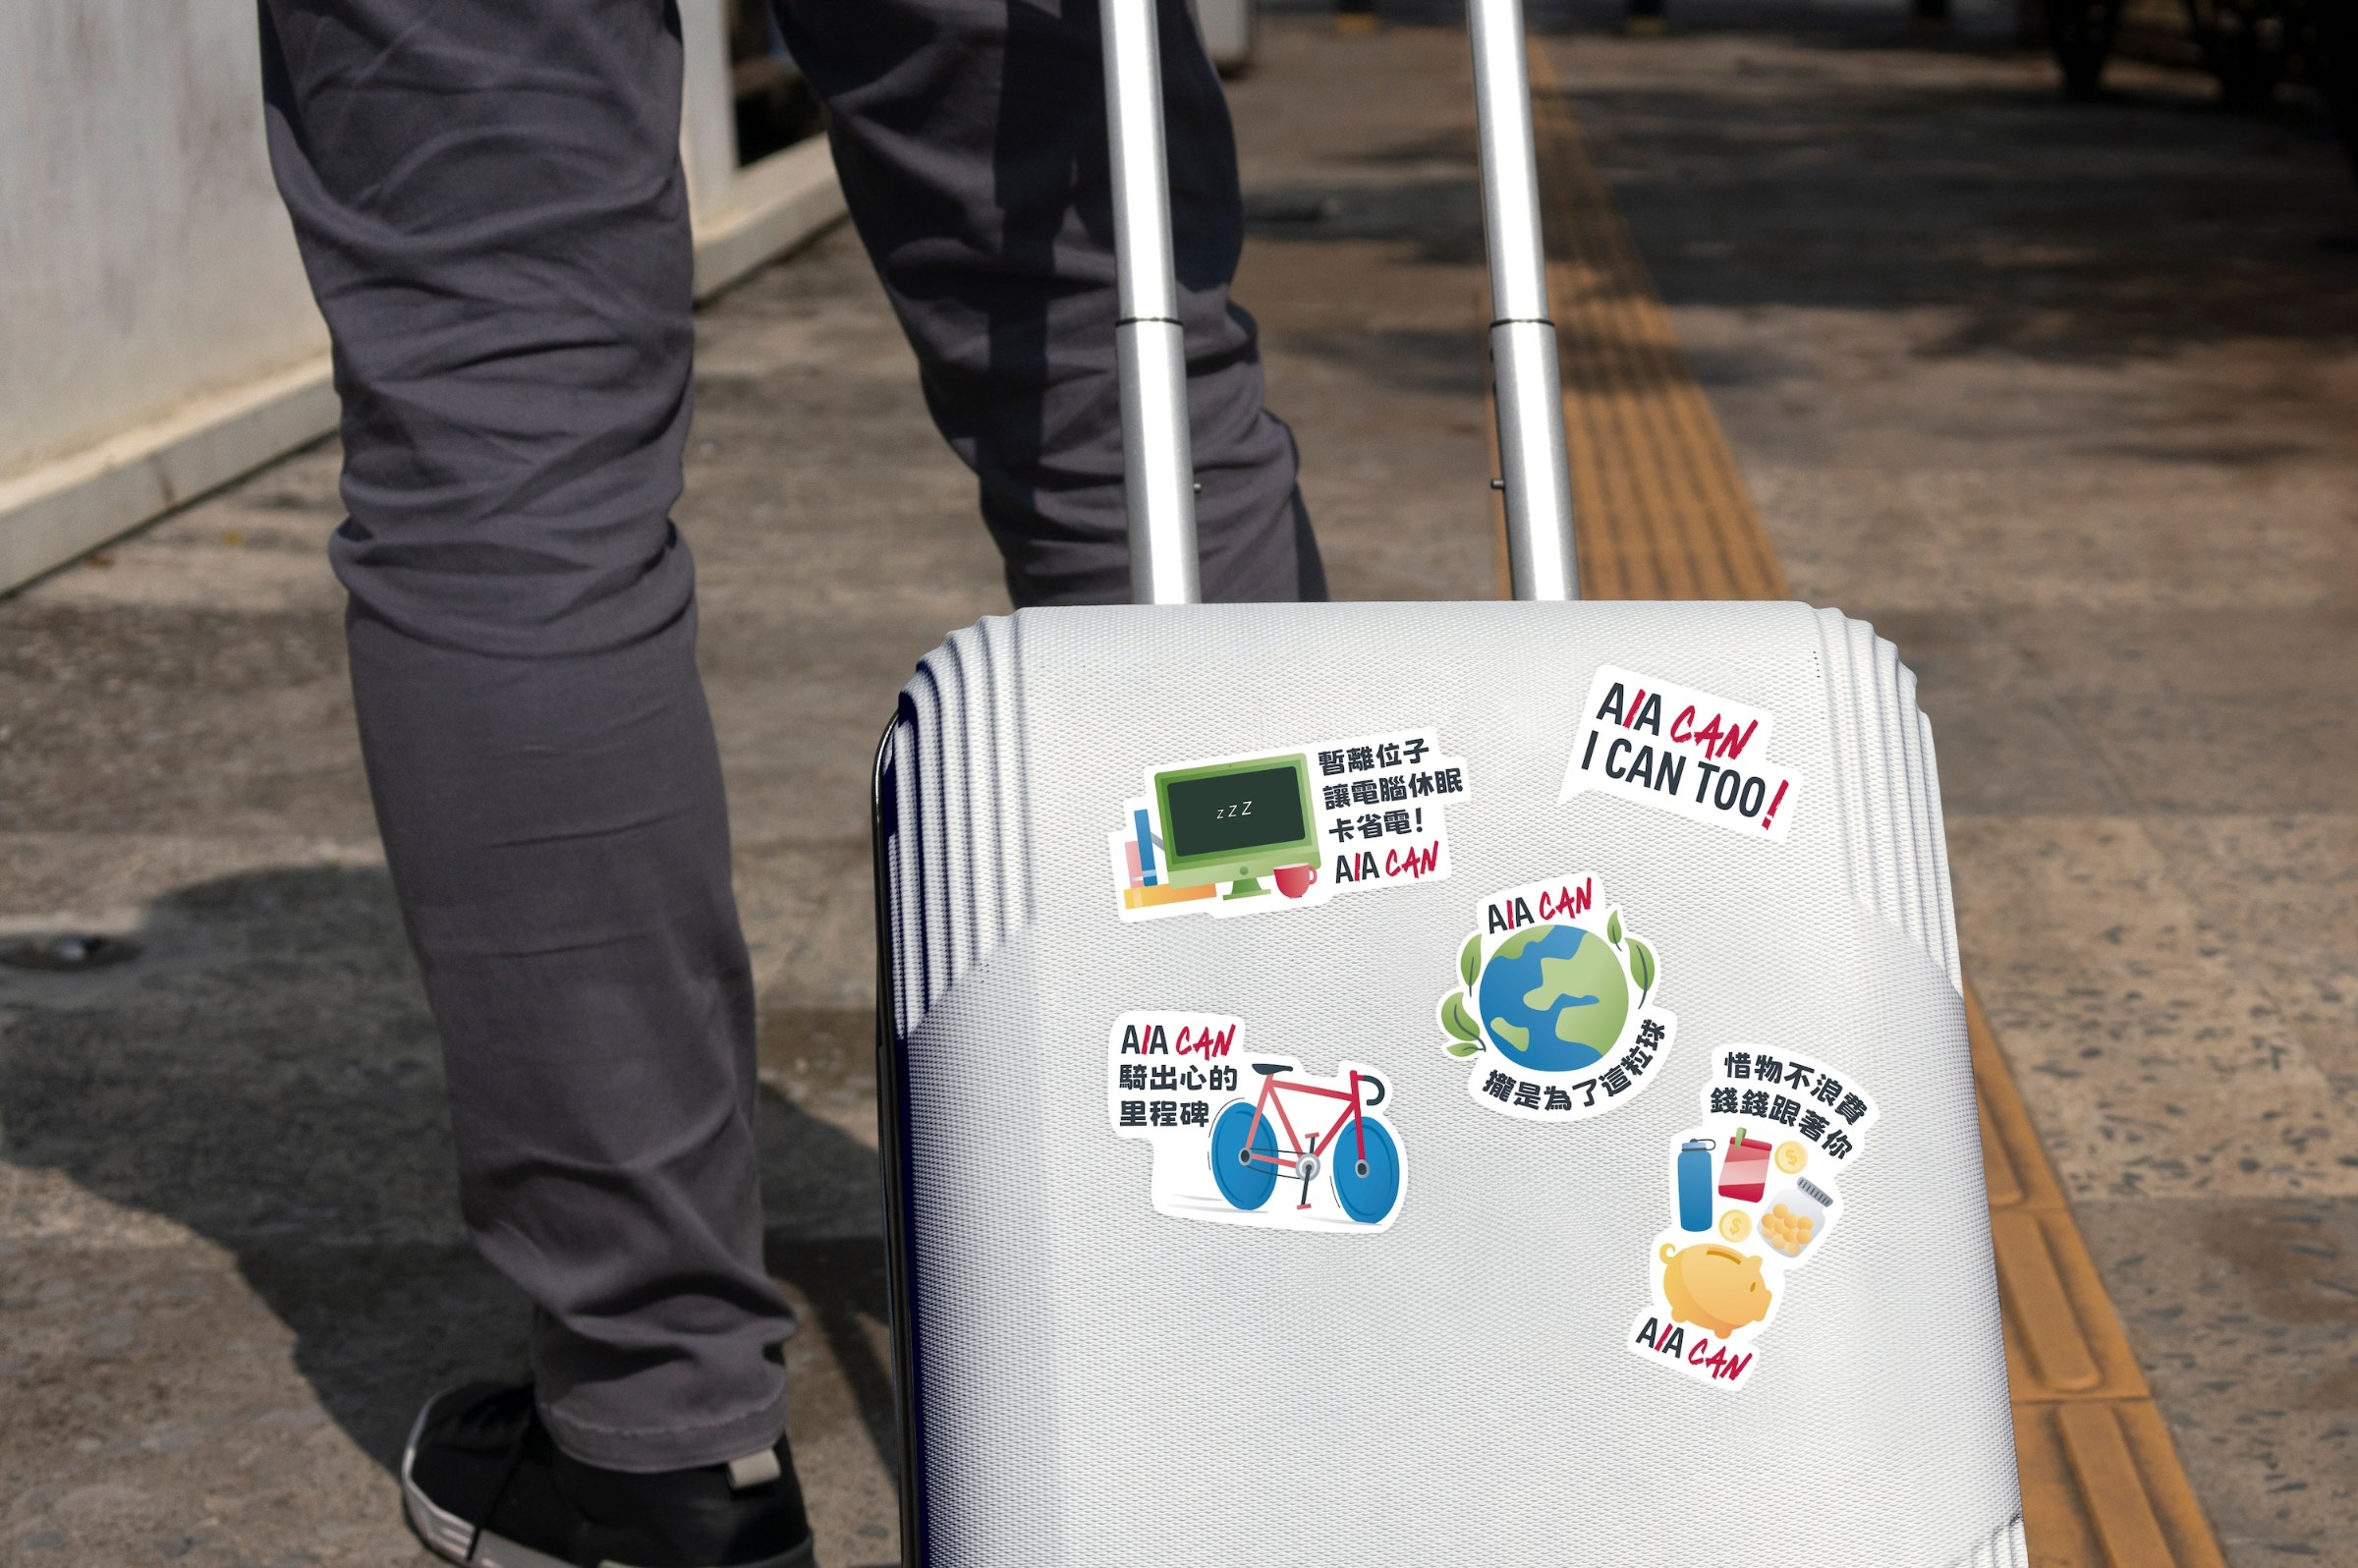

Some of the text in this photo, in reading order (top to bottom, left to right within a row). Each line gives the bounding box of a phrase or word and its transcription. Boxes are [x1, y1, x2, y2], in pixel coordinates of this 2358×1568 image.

[1596, 682, 1759, 761] AIA CAN
[1318, 738, 1430, 776] 暫離位子
[1581, 729, 1789, 831] I CAN TOO!
[1322, 767, 1463, 811] 讓電腦休眠
[1335, 840, 1439, 884] AIA CAN
[1488, 877, 1592, 934] AIA CAN
[1121, 1024, 1236, 1061] AIA CAN
[1482, 1018, 1665, 1111] 攏是為了這粒球
[1119, 1064, 1238, 1092] 騎出心的
[1723, 1051, 1868, 1126] 惜物不浪費
[1119, 1100, 1209, 1128] 里程碑
[1710, 1087, 1853, 1160] 錢錢跟著你
[1635, 1316, 1753, 1381] AIA CAN
